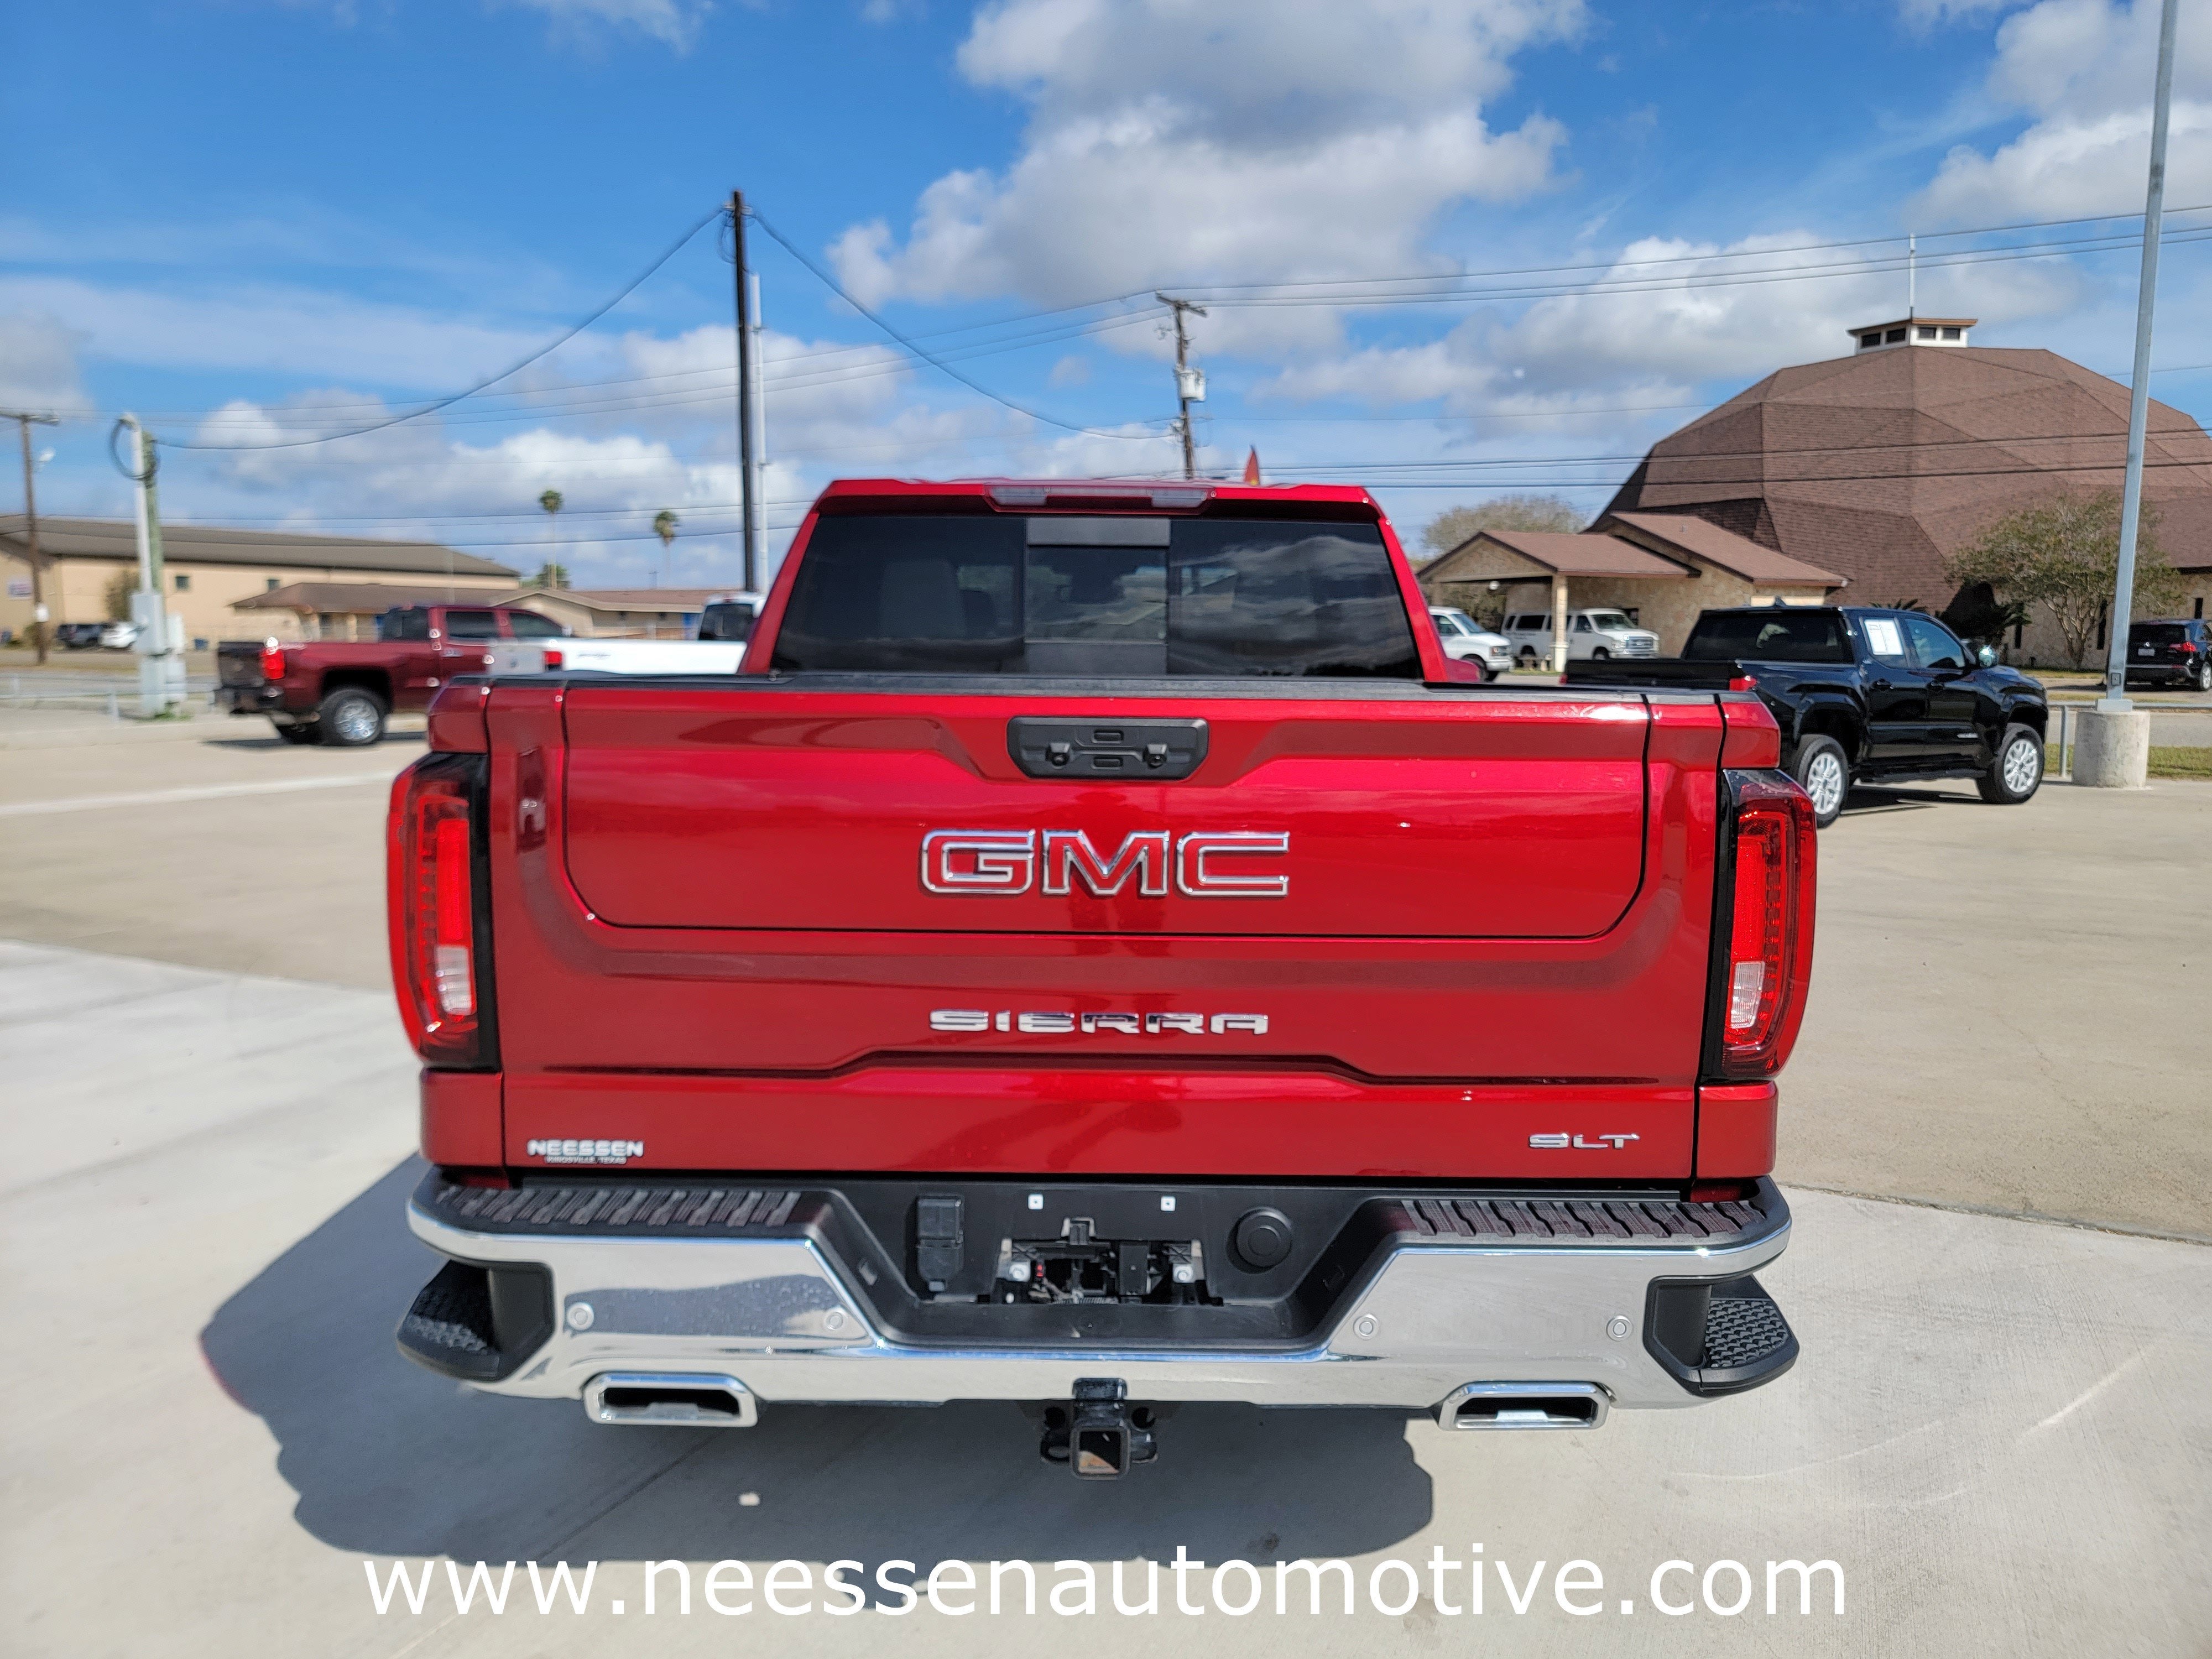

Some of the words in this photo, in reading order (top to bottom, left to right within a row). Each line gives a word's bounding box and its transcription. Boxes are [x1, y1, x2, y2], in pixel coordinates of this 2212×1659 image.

[921, 829, 1290, 897] GMC
[929, 1009, 1269, 1035] SIERRA
[527, 1139, 644, 1157] NEESSEN
[1529, 1133, 1640, 1149] SLT
